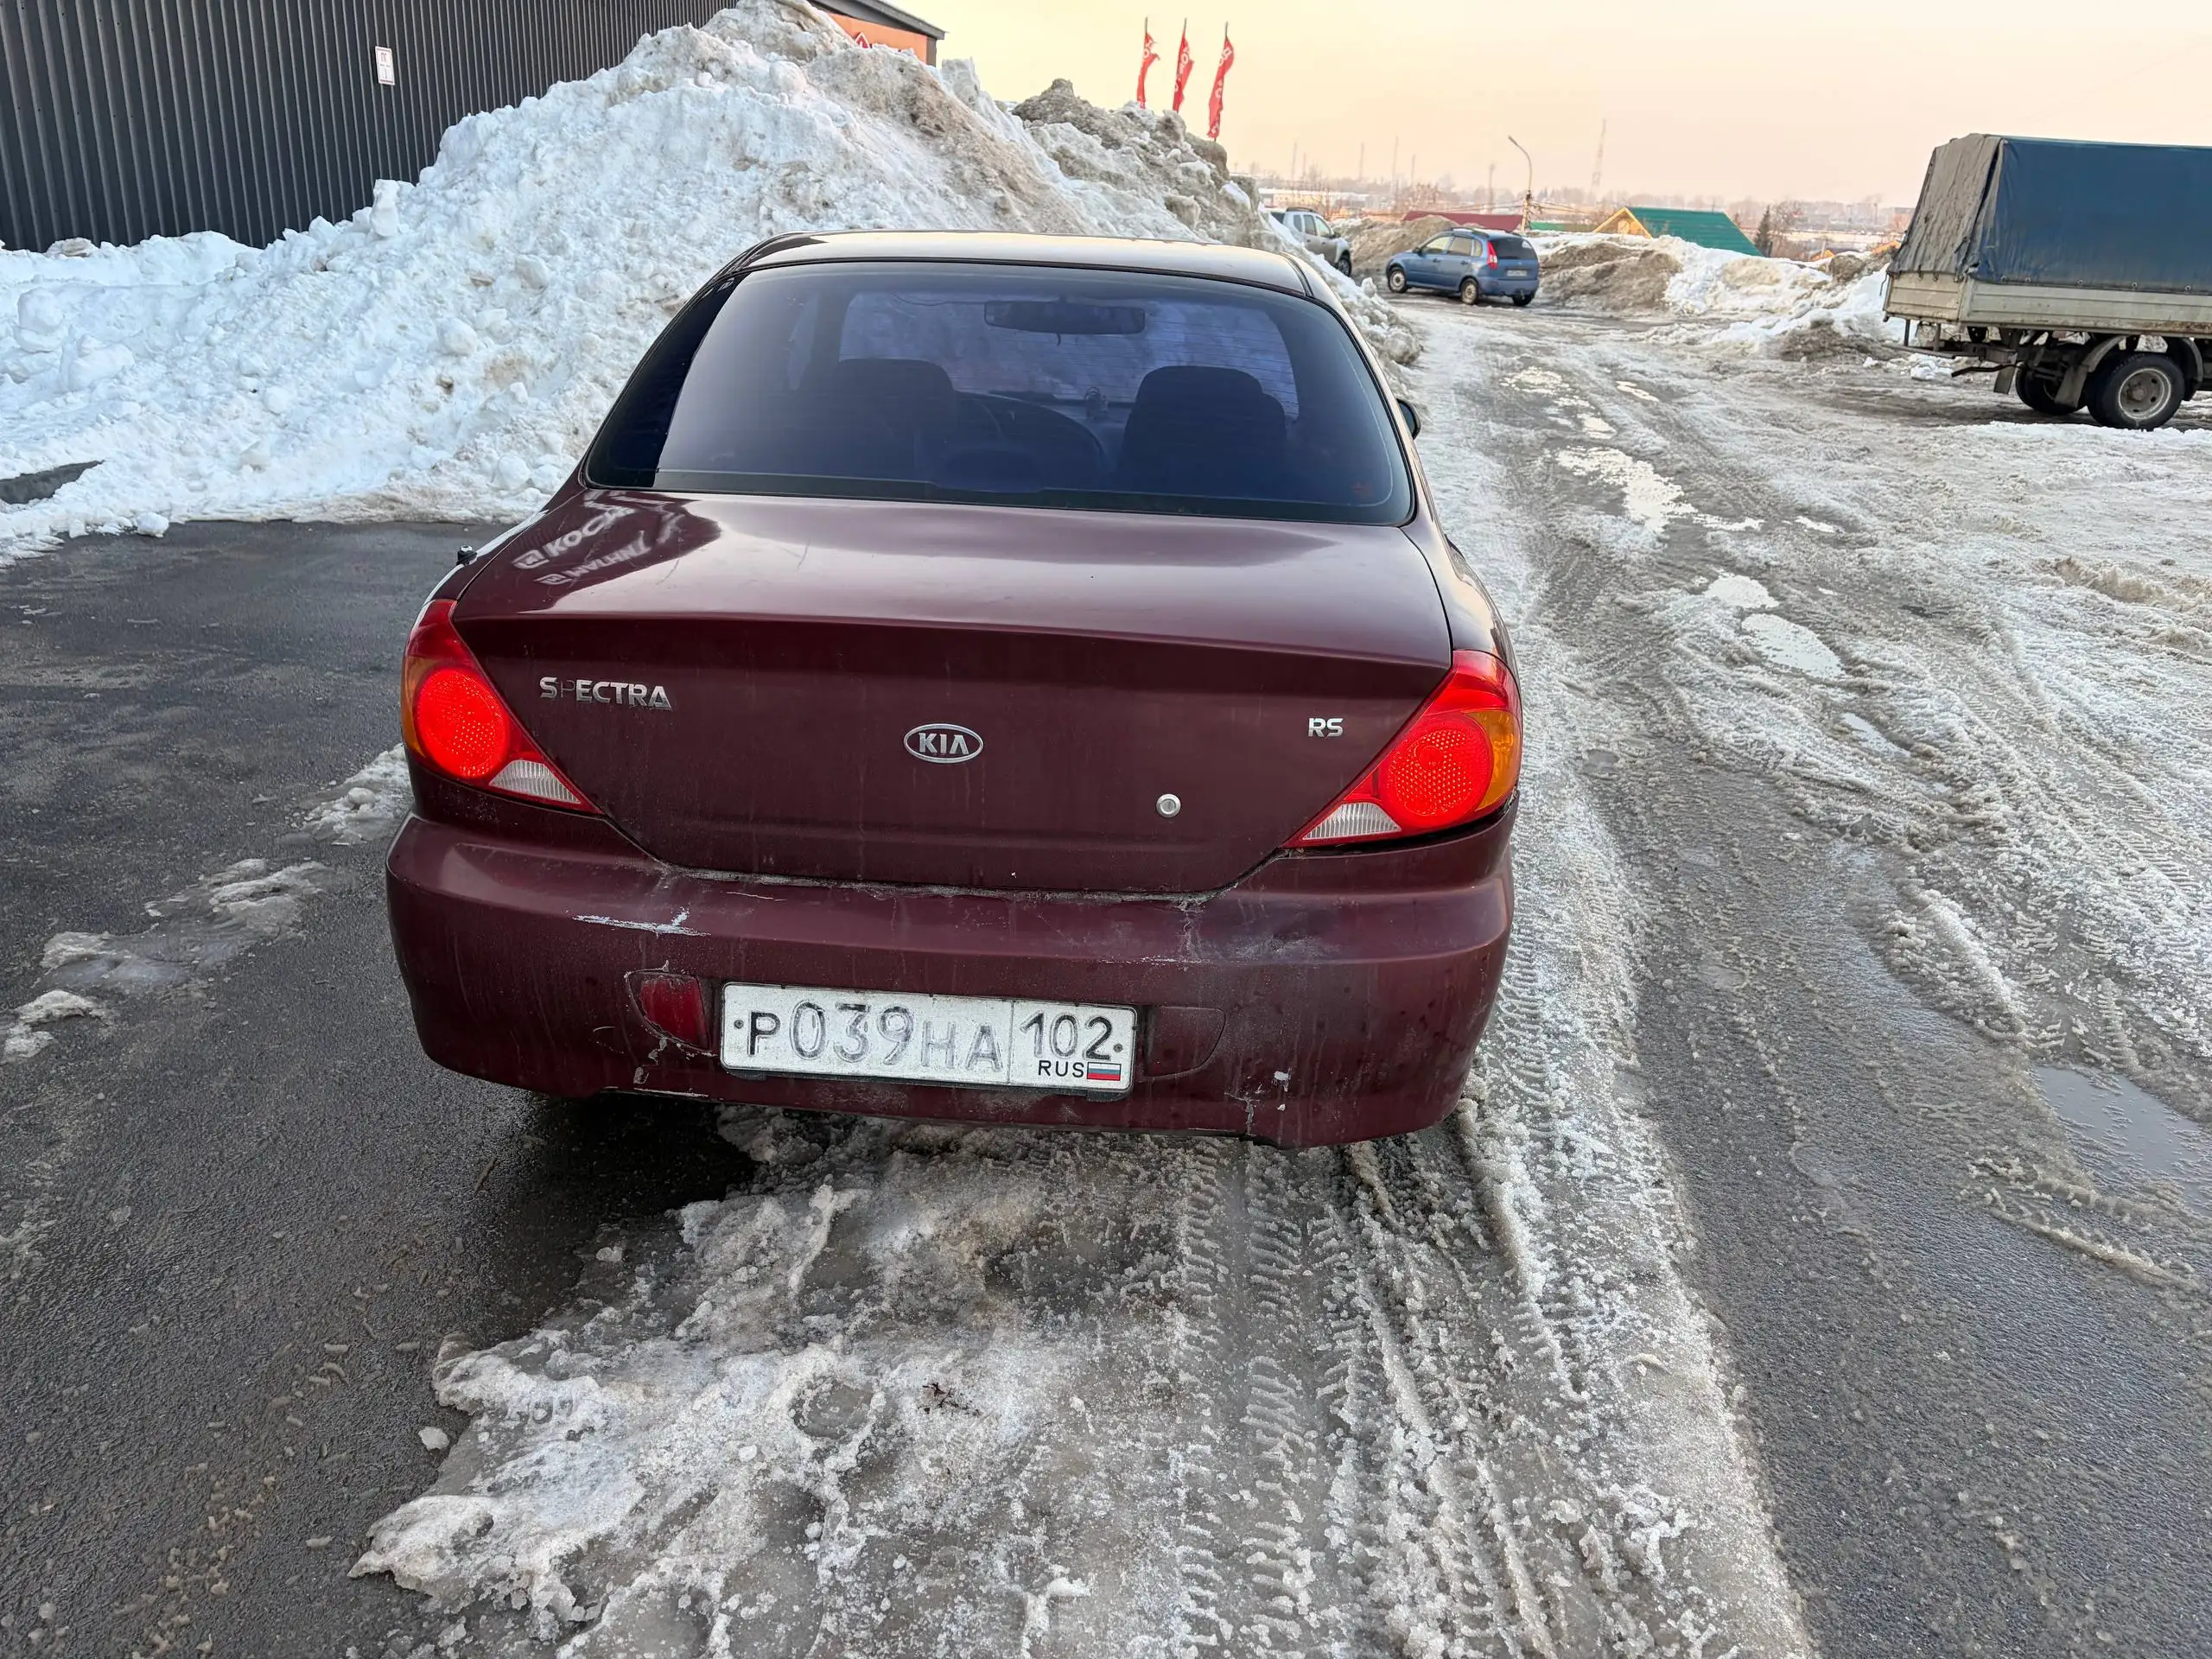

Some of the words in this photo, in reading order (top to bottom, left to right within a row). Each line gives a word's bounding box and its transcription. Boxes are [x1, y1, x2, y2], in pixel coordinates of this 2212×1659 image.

[1308, 717, 1344, 737] RS
[918, 733, 969, 754] KIA
[1020, 1010, 1111, 1061] 102
[1038, 1059, 1084, 1078] RUS
